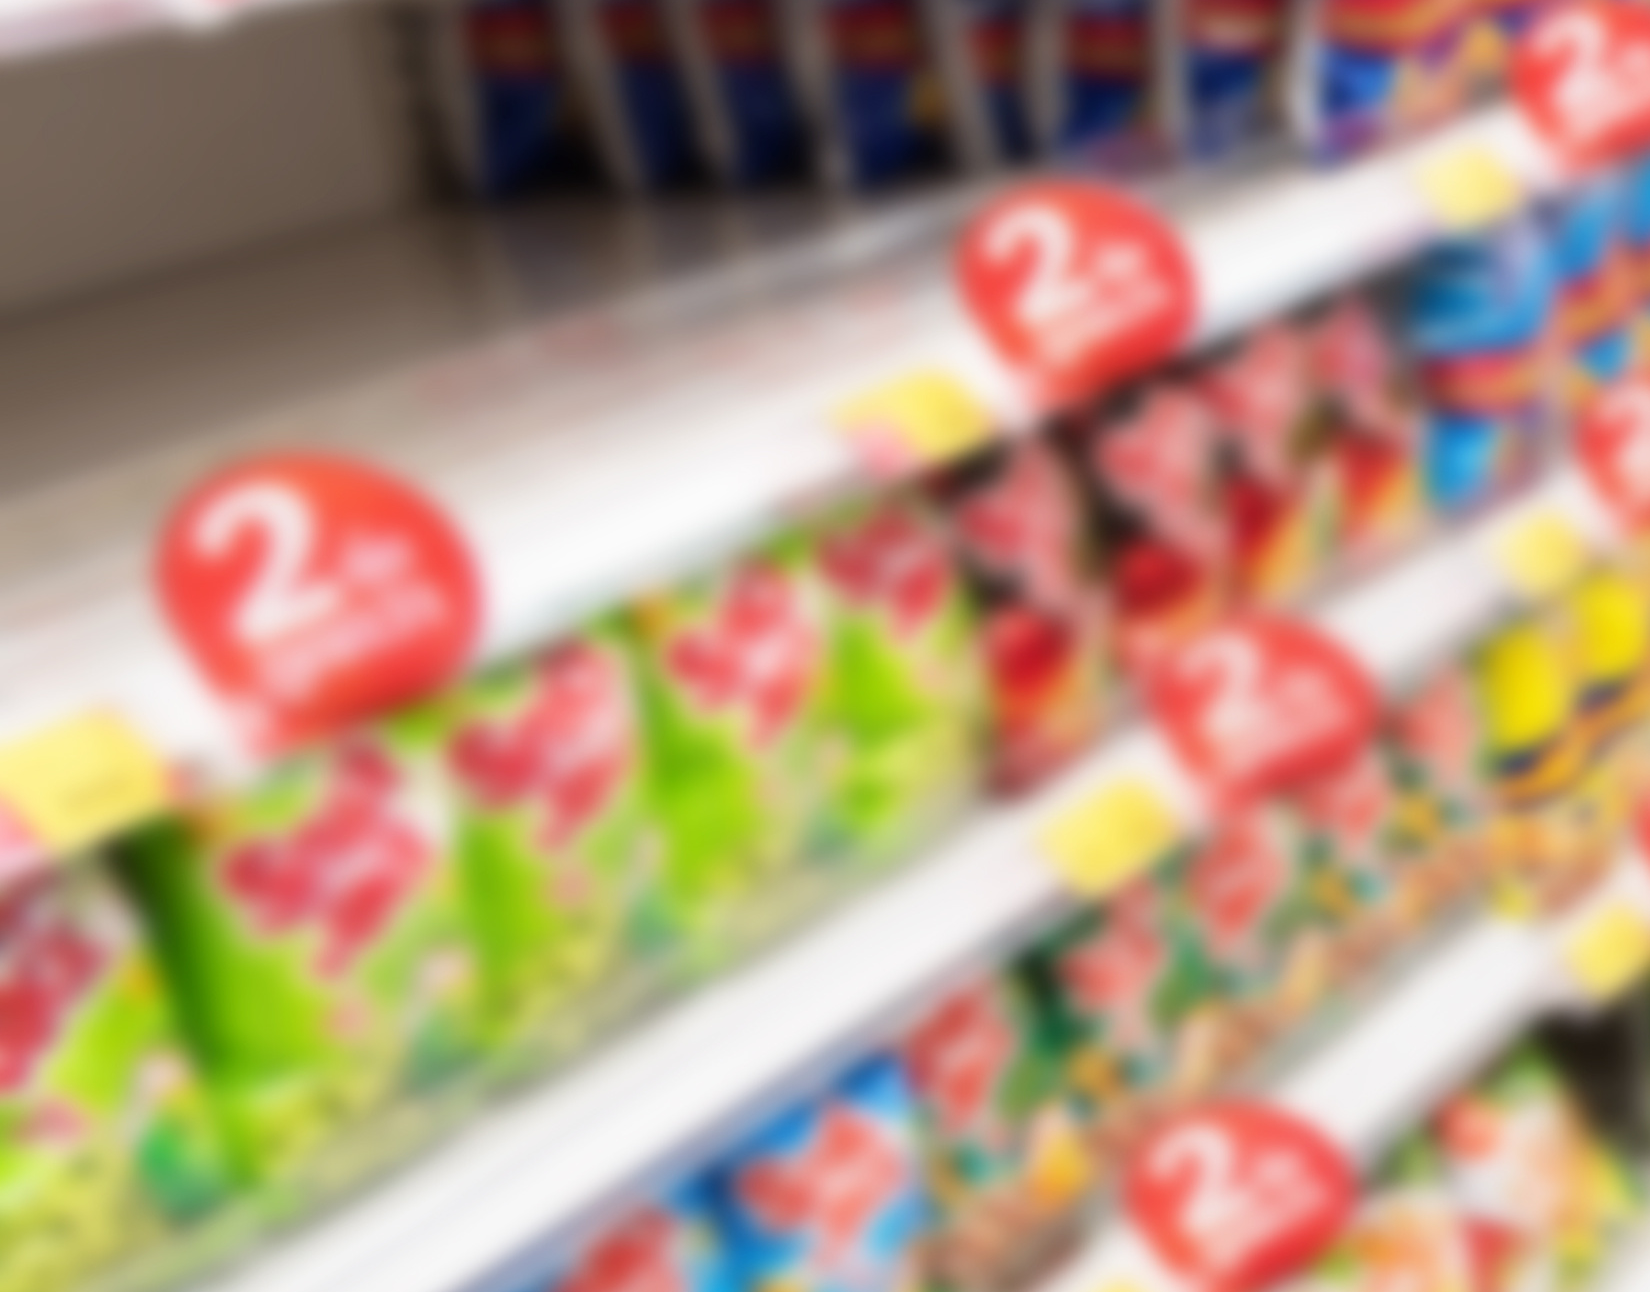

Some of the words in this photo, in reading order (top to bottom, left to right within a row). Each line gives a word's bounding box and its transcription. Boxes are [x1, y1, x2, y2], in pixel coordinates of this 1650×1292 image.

[985, 201, 1098, 321] 2
[192, 480, 338, 639] 2
[1172, 629, 1280, 737] 2
[1145, 1121, 1258, 1229] 2
